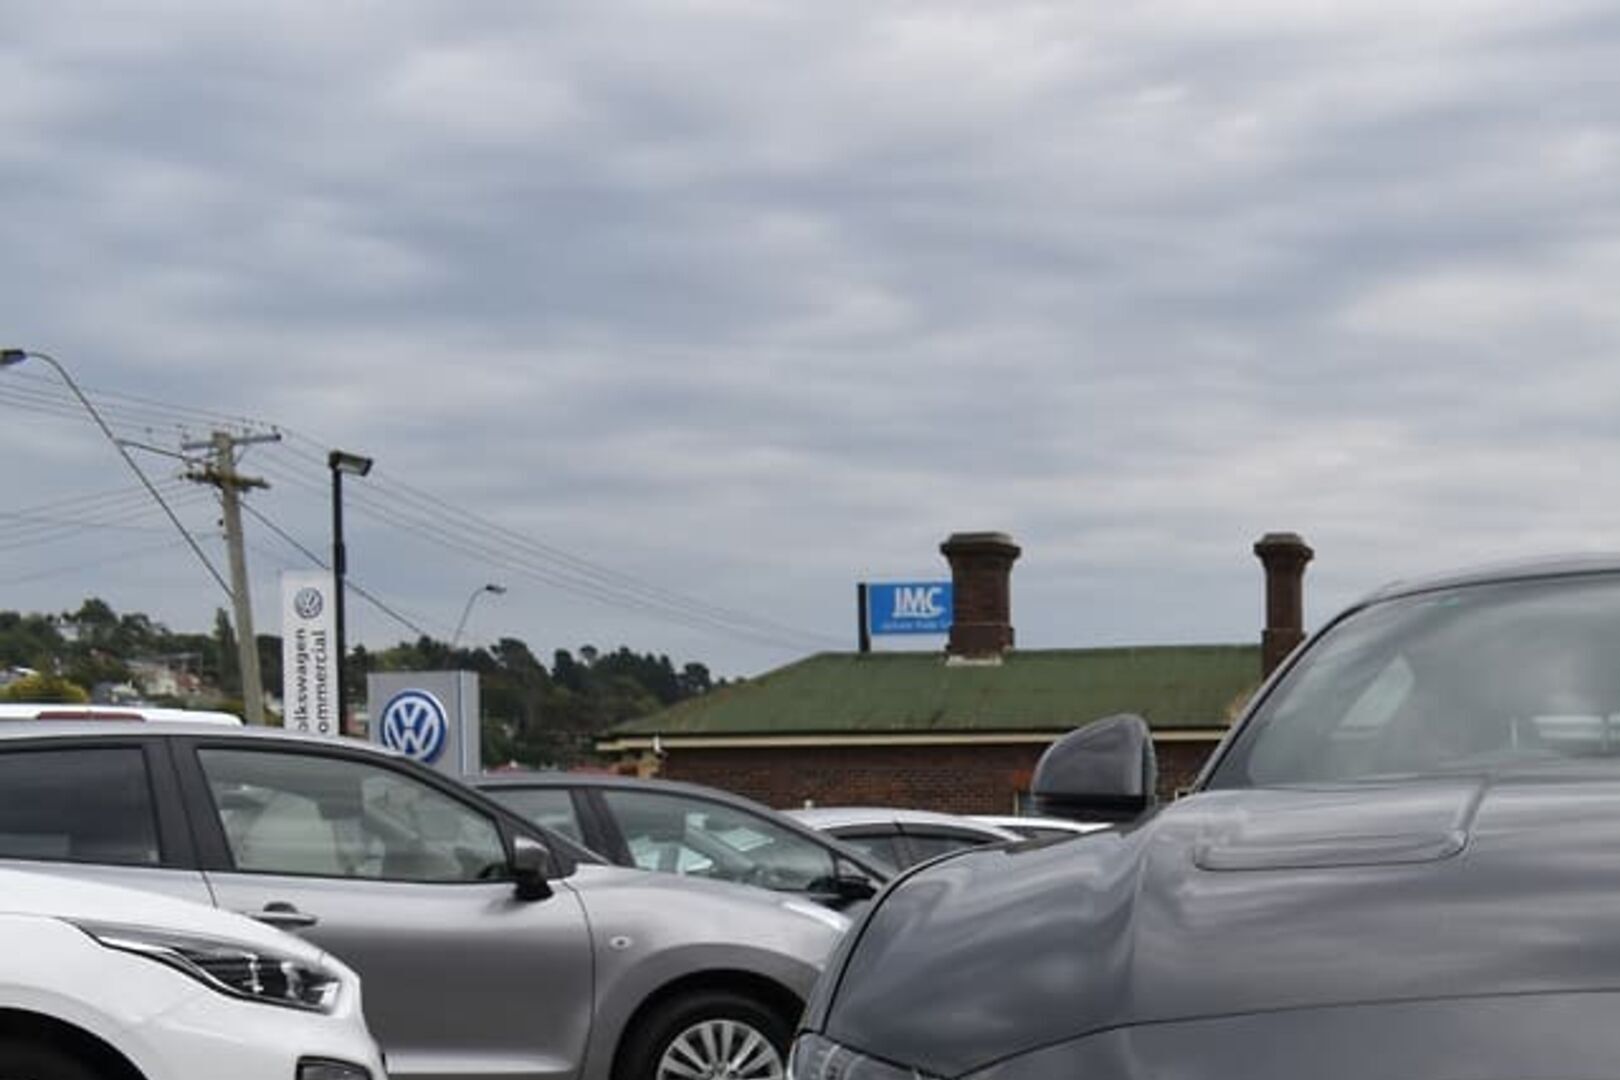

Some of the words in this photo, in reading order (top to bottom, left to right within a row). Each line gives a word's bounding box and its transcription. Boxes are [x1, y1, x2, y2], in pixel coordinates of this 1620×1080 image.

[893, 586, 946, 615] JMC
[295, 629, 309, 732] olkswagen
[312, 630, 329, 733] ommercial
